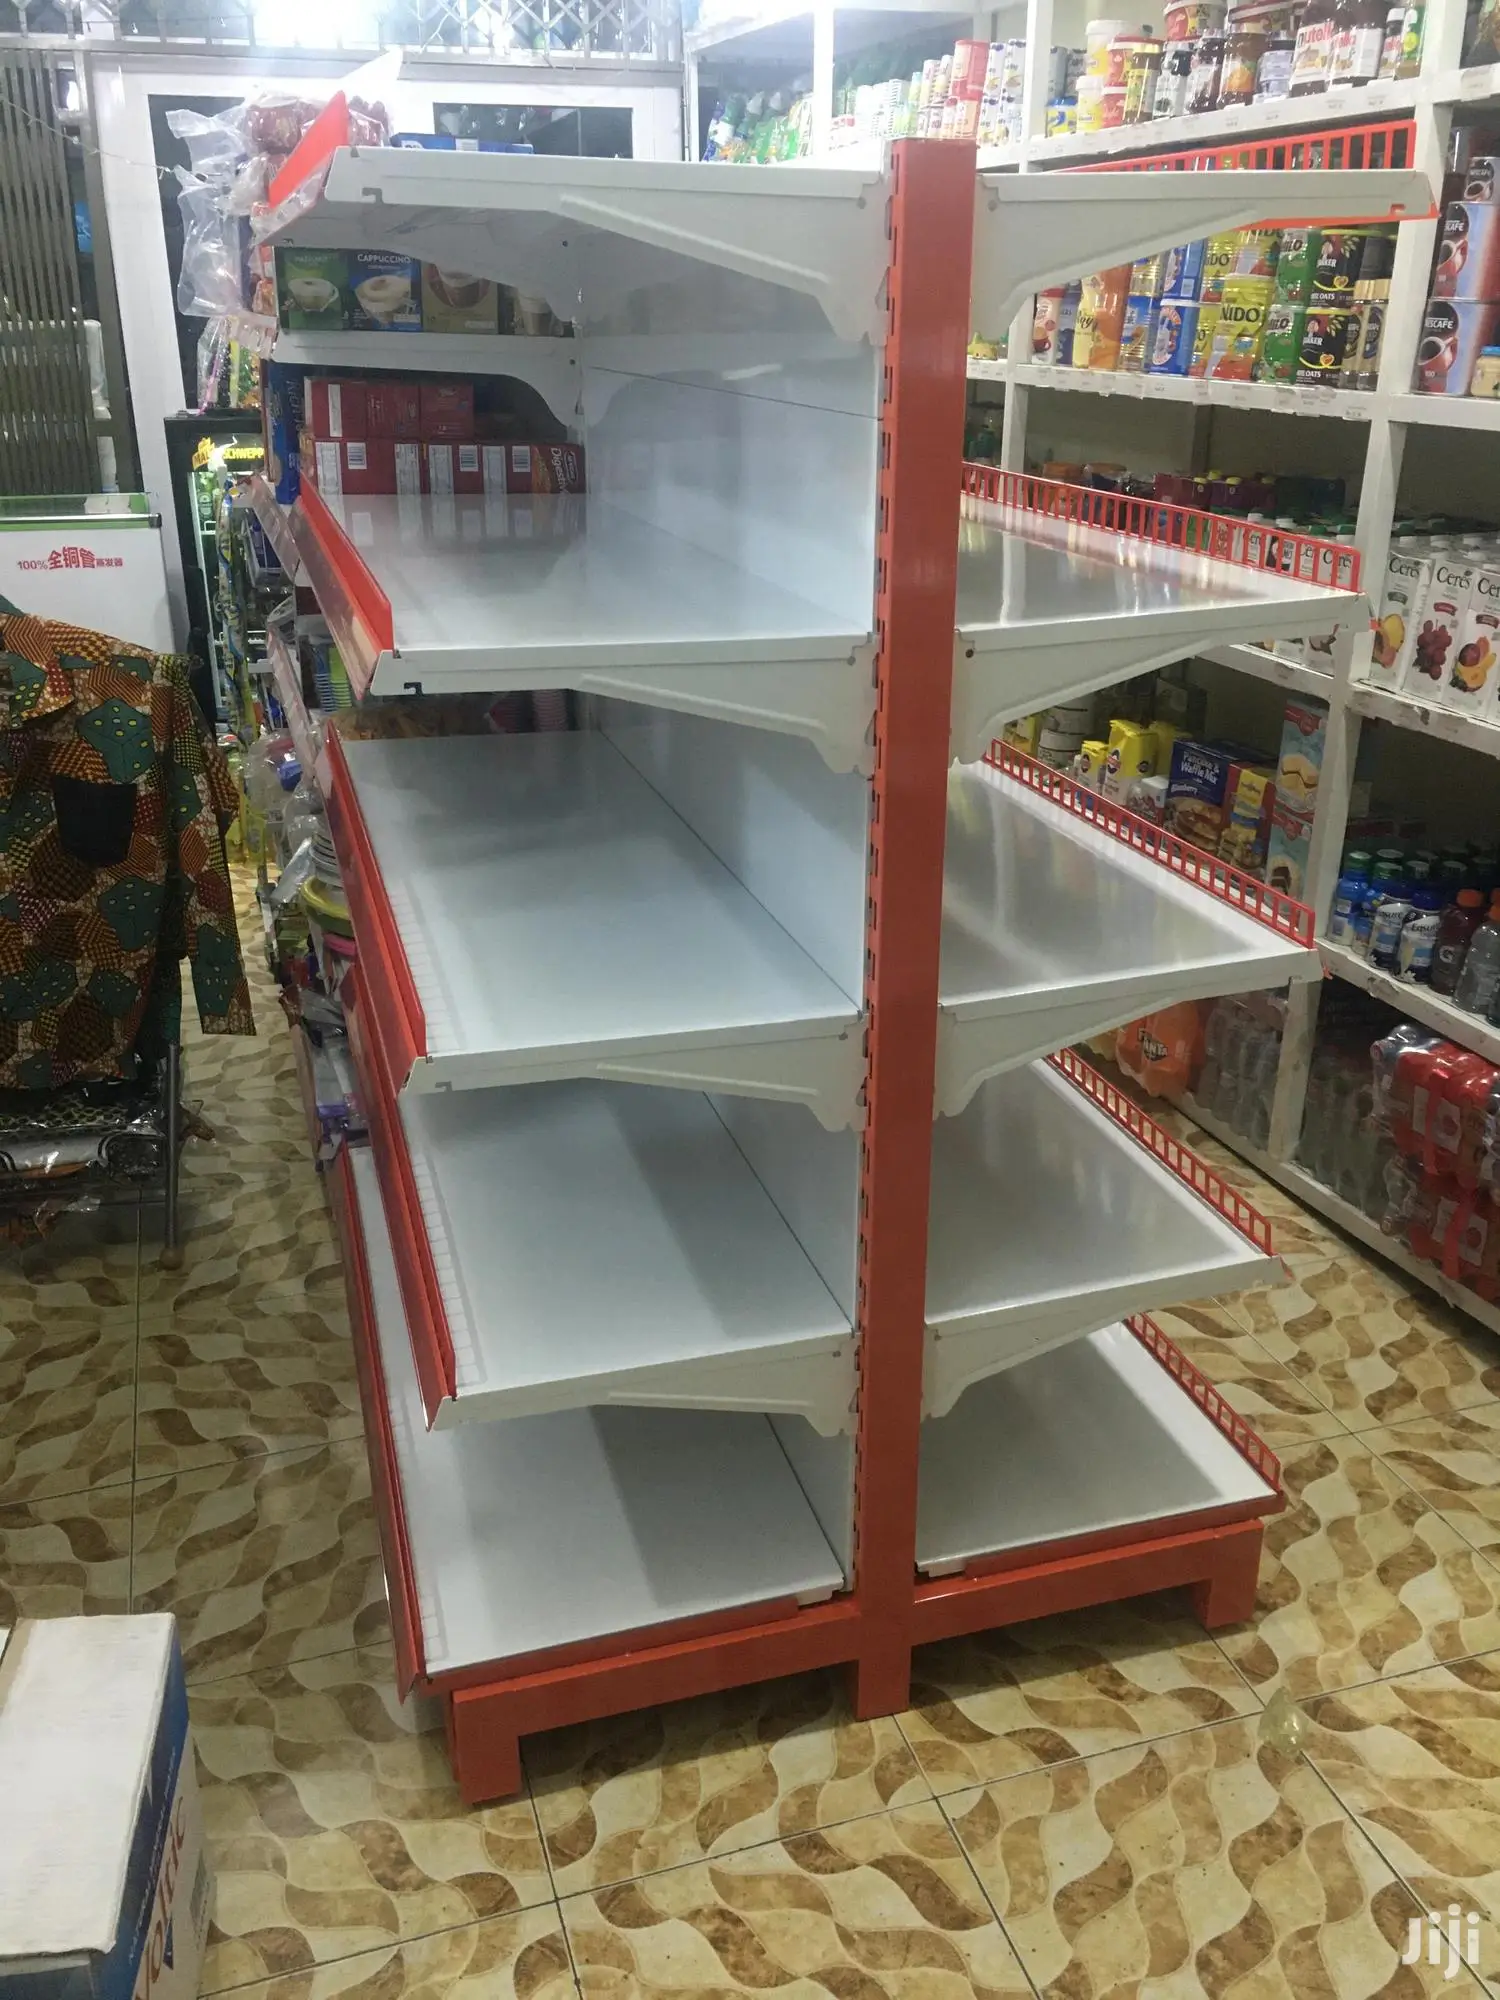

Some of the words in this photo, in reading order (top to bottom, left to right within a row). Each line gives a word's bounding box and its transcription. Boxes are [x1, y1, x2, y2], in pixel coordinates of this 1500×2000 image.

[1298, 21, 1335, 48] nutell
[357, 253, 411, 264] CAPPUCCINO
[1222, 305, 1261, 323] NIDO
[1436, 566, 1471, 590] Ceres
[1477, 577, 1500, 598] Cer
